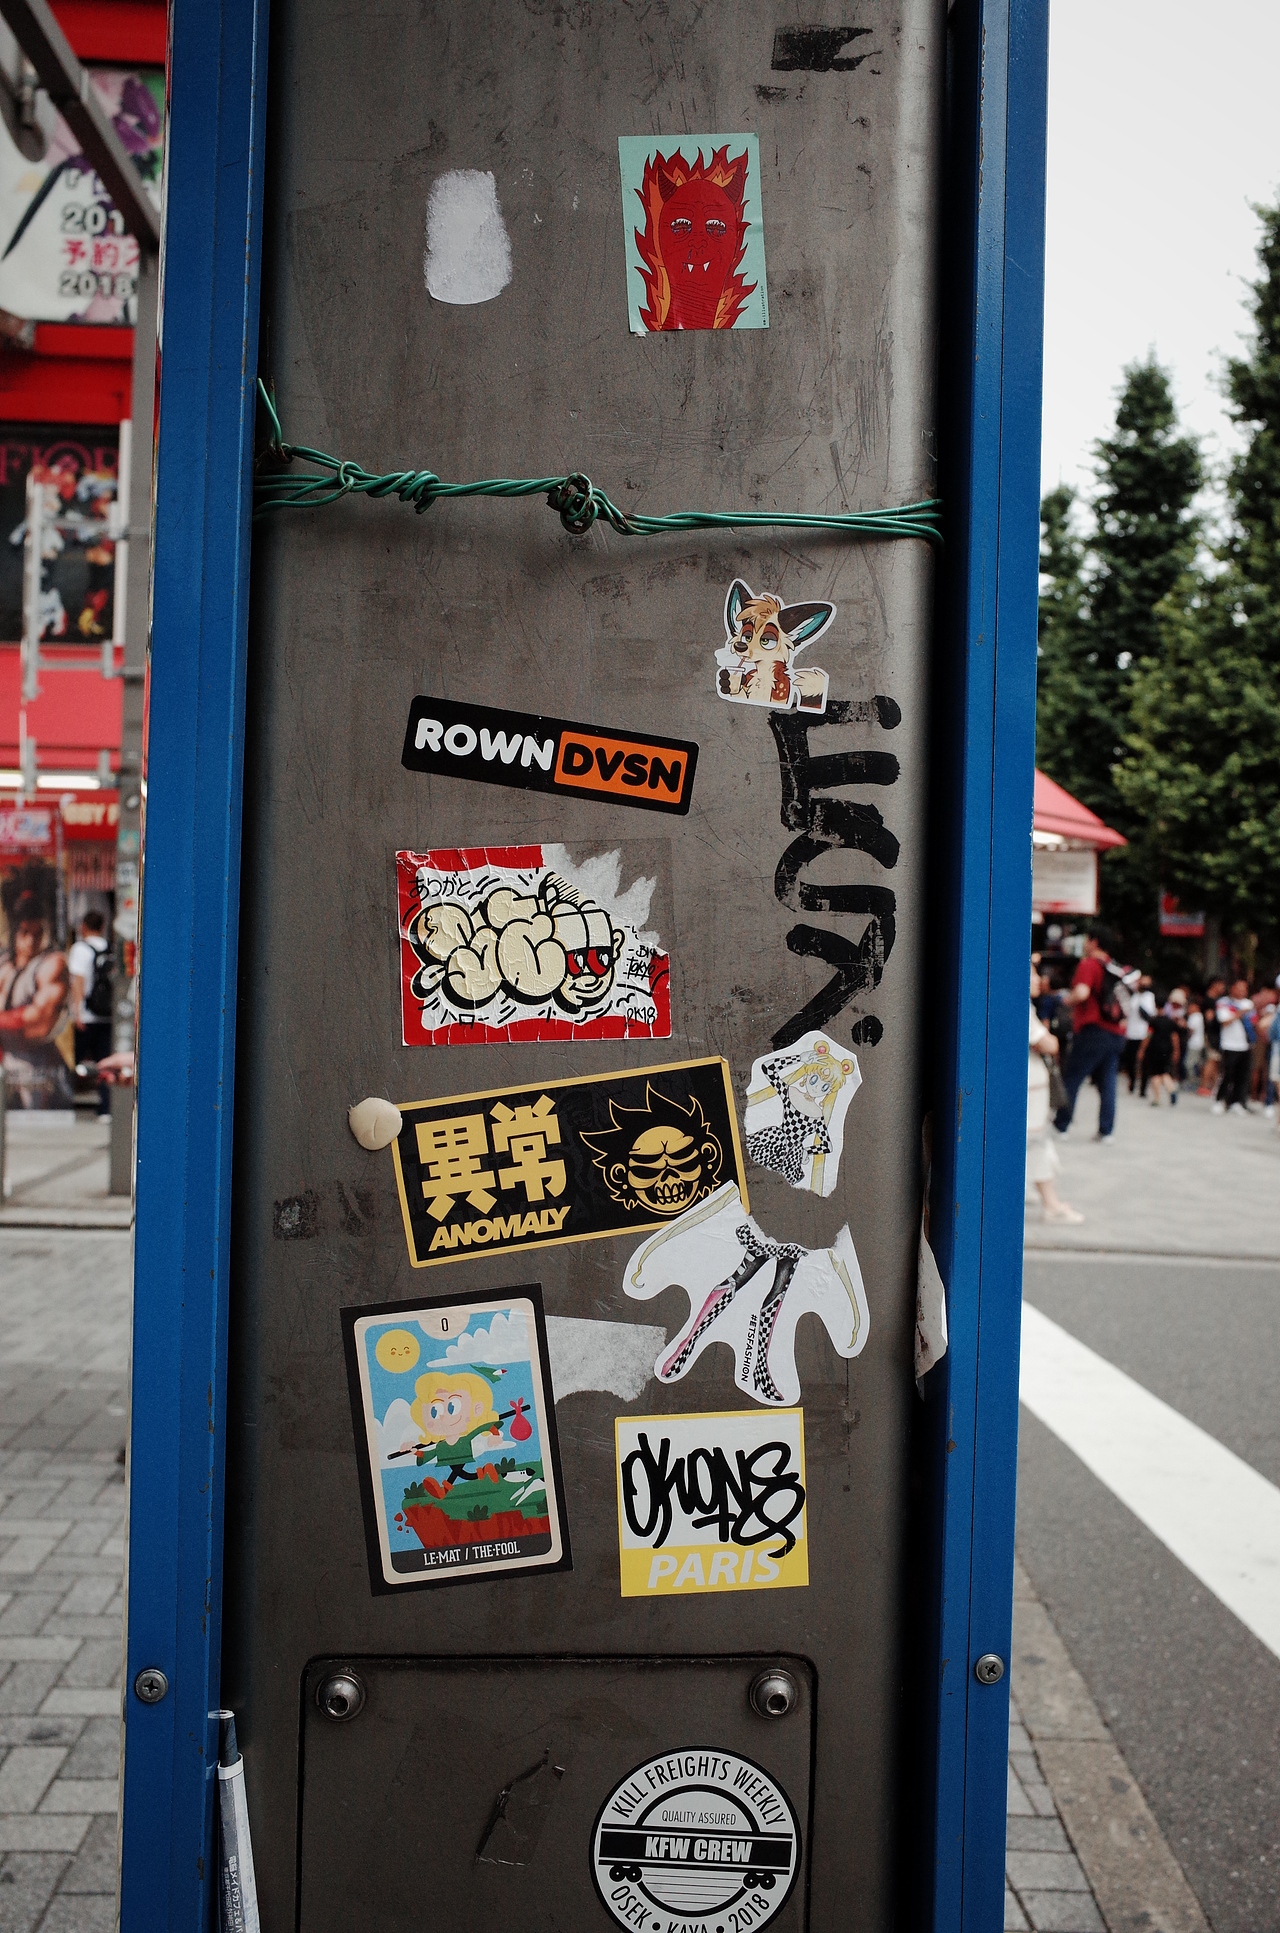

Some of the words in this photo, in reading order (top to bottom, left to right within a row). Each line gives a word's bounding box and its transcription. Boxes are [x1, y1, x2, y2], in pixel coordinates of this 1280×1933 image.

[414, 718, 555, 771] ROWN
[561, 742, 683, 793] DVSN
[415, 1094, 567, 1222] 異常
[428, 1206, 571, 1252] ANOMALY
[741, 1314, 758, 1382] #ETSFASHION
[647, 1549, 780, 1588] PARIS
[611, 1782, 649, 1818] KILL
[644, 1755, 731, 1789] FREIGHTS
[732, 1766, 787, 1825] WEEKLY
[661, 1810, 696, 1824] QUALITY
[698, 1812, 737, 1826] ASSURED
[645, 1836, 690, 1859] KFW
[693, 1839, 753, 1863] CREW
[610, 1885, 653, 1929] OSEK
[727, 1893, 770, 1933] 2018
